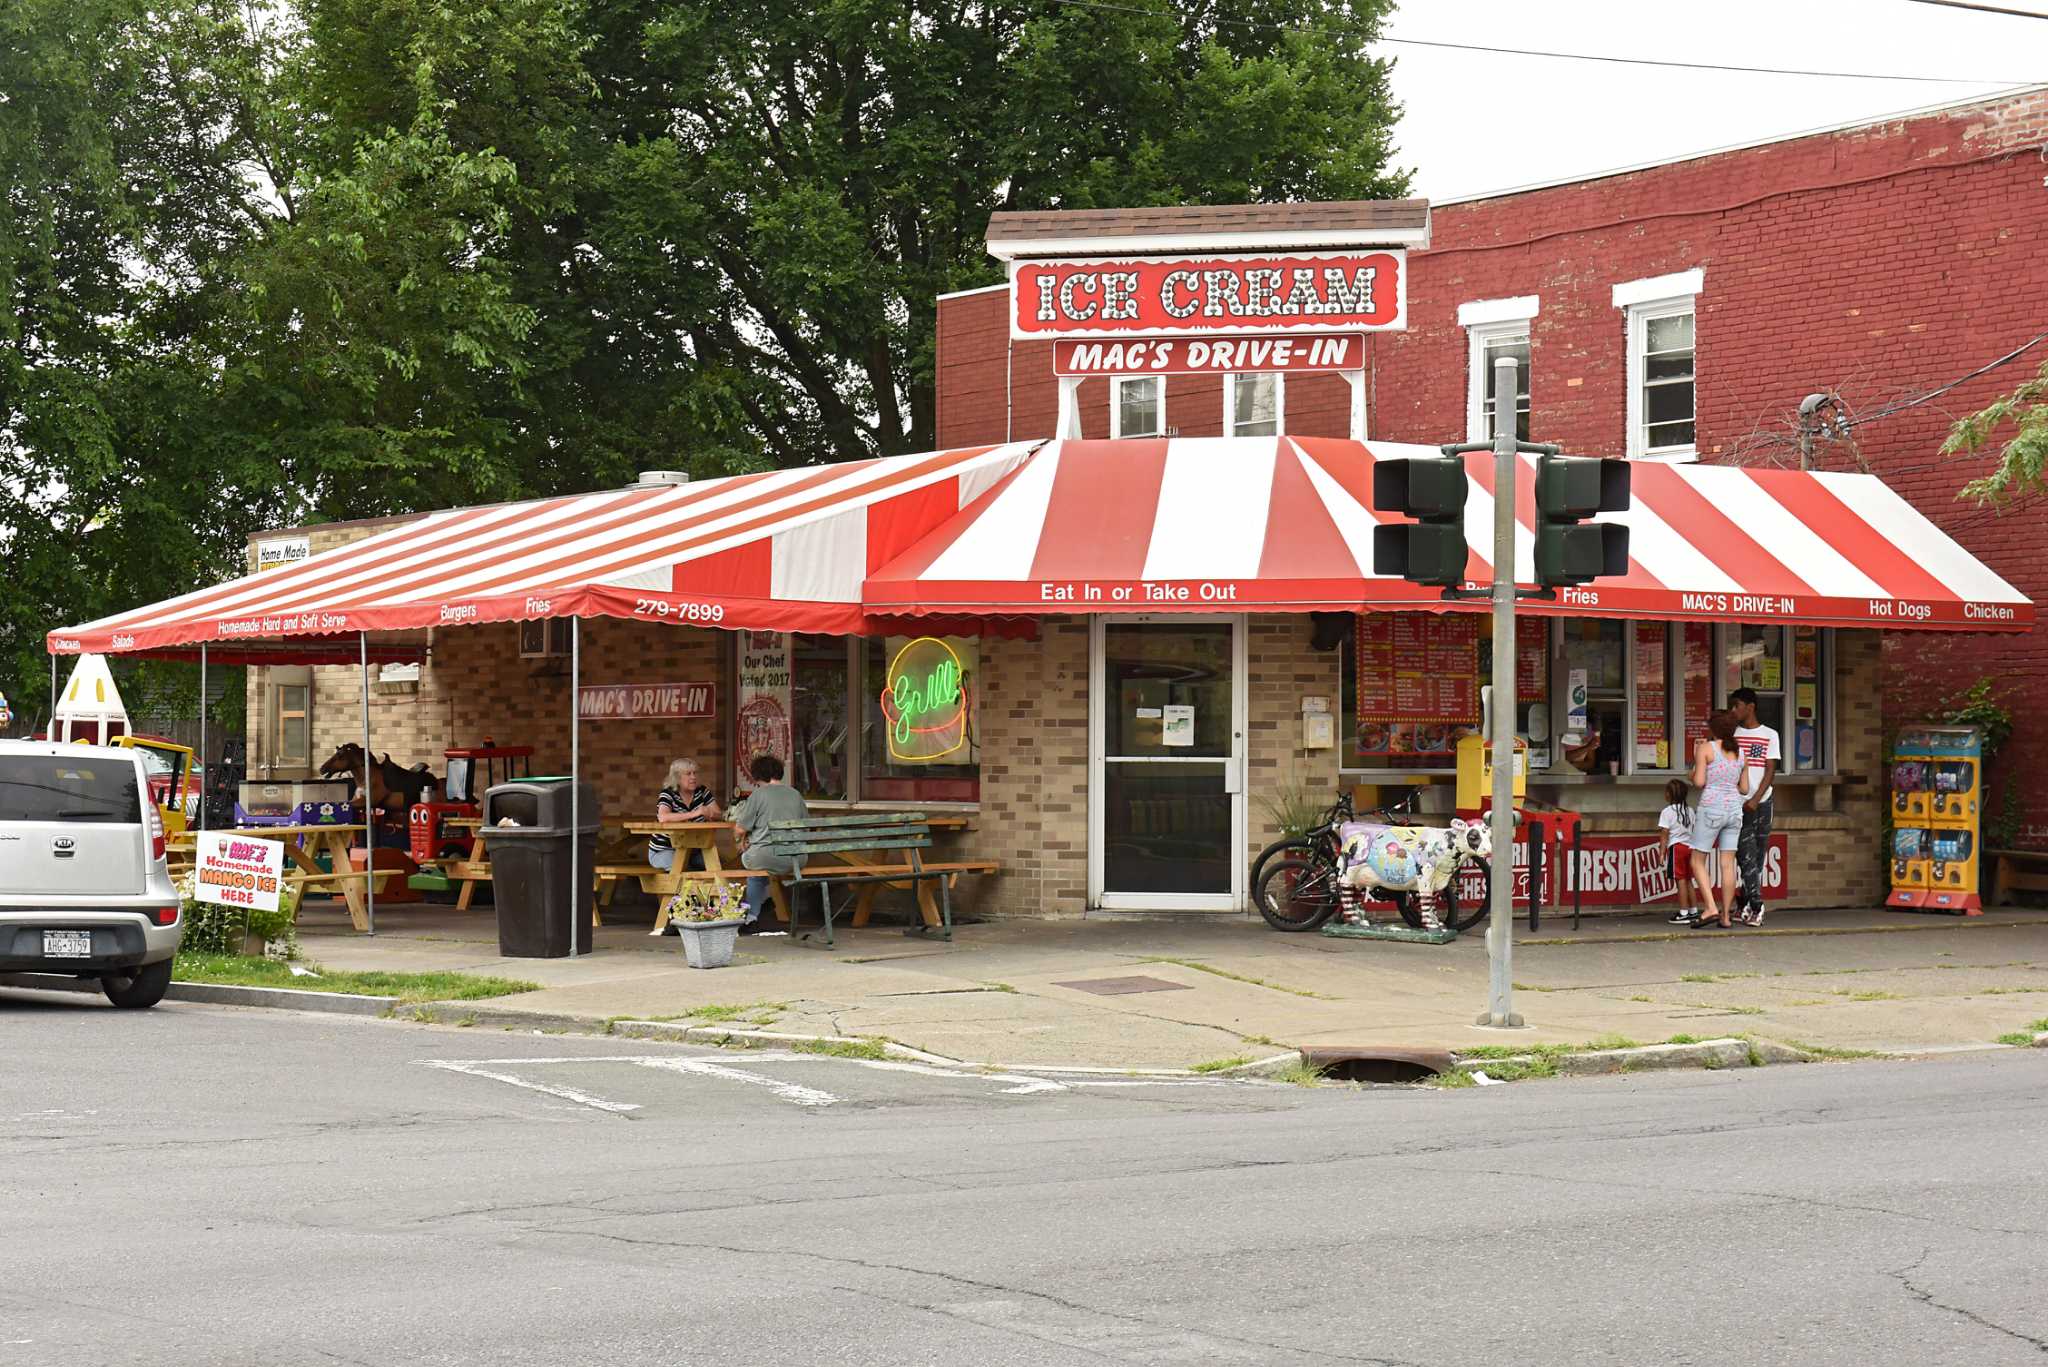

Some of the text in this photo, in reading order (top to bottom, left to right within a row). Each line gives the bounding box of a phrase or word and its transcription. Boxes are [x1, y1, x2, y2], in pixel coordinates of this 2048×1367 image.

[1035, 266, 1377, 321] ICE CREAM
[1068, 338, 1349, 371] MAC'S DRIVE-IN
[261, 544, 307, 560] Home Made
[1041, 582, 1237, 600] Eat In or Take Out
[1563, 586, 1599, 605] Fries
[440, 603, 477, 622] Burgers
[525, 597, 551, 614] Fries
[633, 598, 724, 622] 279-7899
[1682, 593, 1795, 613] MAC'S DRIVE-IN
[1869, 599, 1932, 619] Hot Dogs
[1964, 602, 2015, 619] Chicken
[218, 612, 347, 634] Homemade Hard and Soft Serve
[111, 634, 135, 648] Salads
[744, 653, 785, 669] Our Chef
[768, 672, 790, 687] 2017
[580, 687, 708, 715] MAC'S DRIVE-IN
[894, 660, 960, 744] Grill
[56, 838, 75, 848] KIA
[206, 855, 273, 874] Homemade
[199, 867, 278, 893] MANGO ICE
[221, 888, 254, 904] HERE
